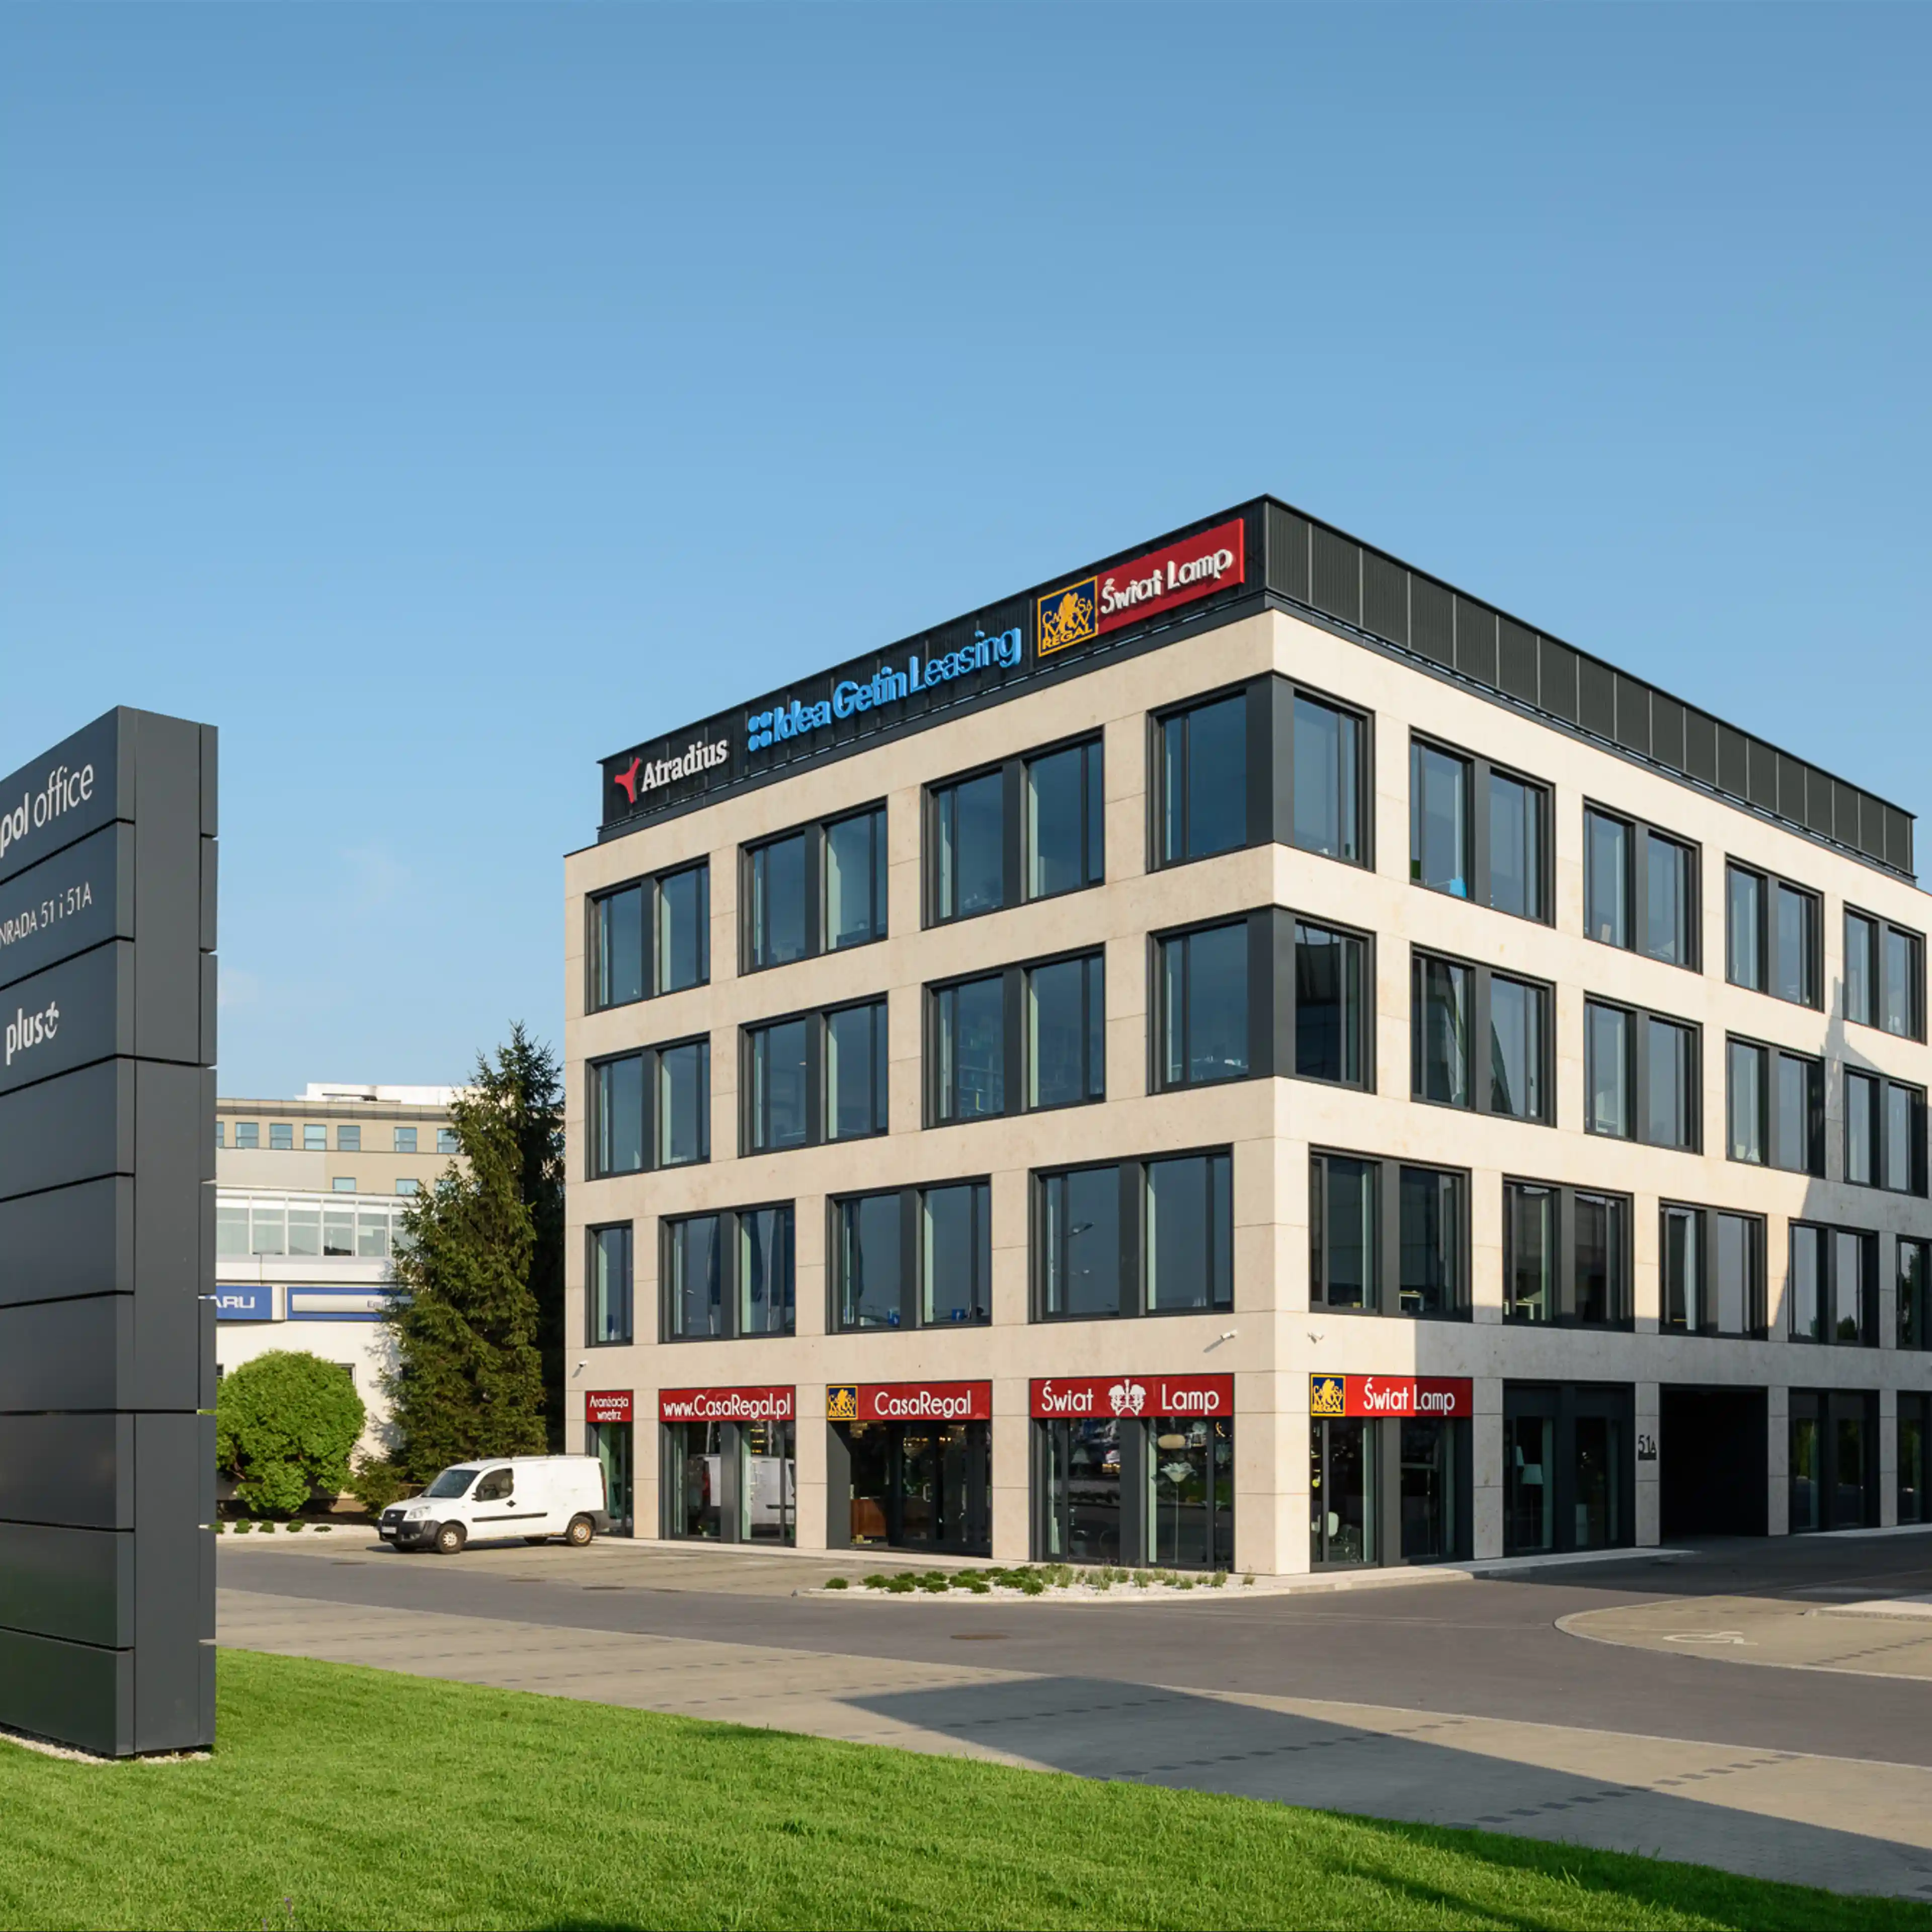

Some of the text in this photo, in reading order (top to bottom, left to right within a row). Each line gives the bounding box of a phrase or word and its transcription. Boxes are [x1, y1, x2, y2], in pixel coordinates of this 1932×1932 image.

[1100, 548, 1234, 614] Świat Lamp
[1042, 623, 1093, 650] REGAL
[773, 626, 1021, 742] Idea Getin Leasing
[640, 738, 728, 792] Atradius
[34, 764, 94, 828] office
[41, 900, 54, 928] 51
[59, 893, 63, 919] i
[66, 881, 92, 915] 51A
[6, 1007, 44, 1066] plus
[663, 1393, 790, 1420] www.CasaRegal.pl
[874, 1390, 972, 1419] CasaRegal
[1041, 1380, 1220, 1415] Świat Lamp
[1363, 1377, 1409, 1410] Świat
[1413, 1384, 1456, 1415] Lamp
